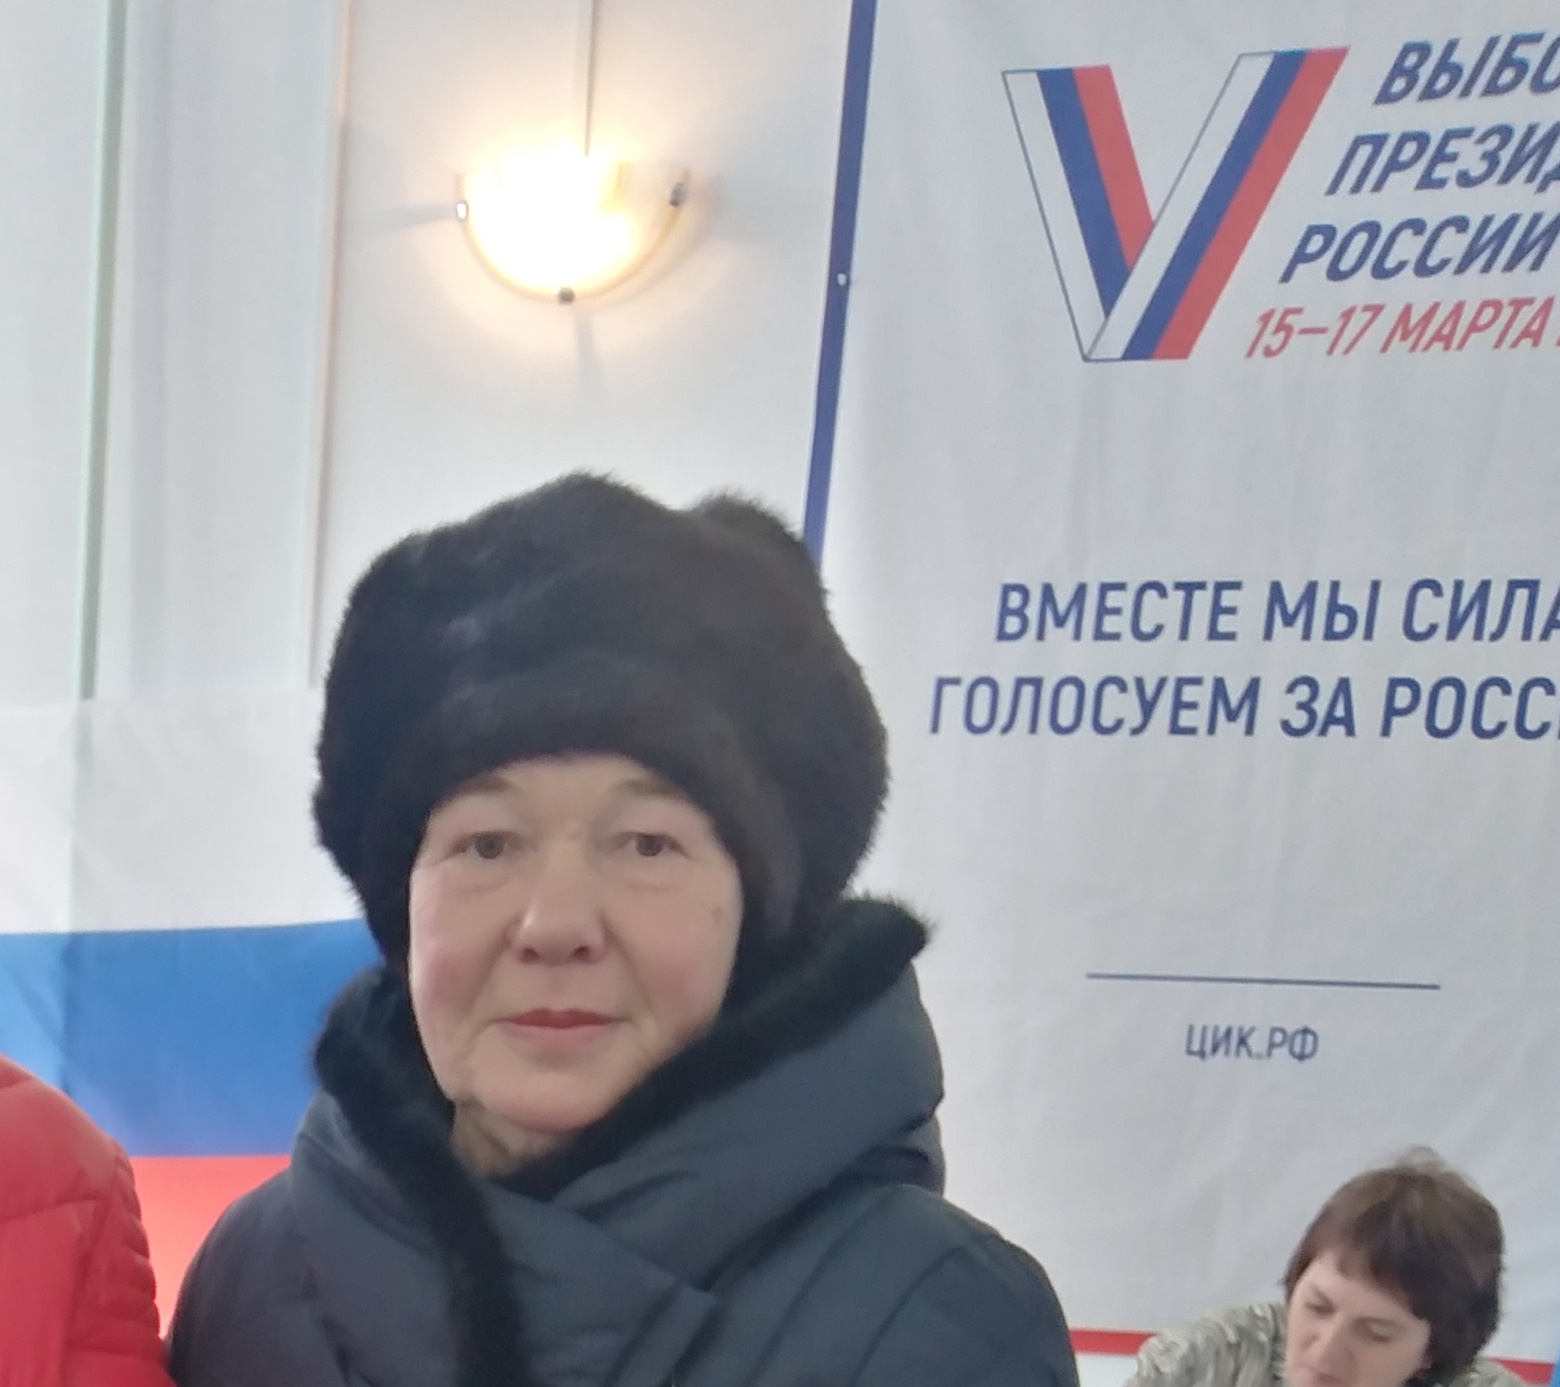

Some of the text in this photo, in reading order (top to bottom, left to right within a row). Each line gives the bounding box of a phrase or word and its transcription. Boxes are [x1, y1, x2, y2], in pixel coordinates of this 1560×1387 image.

[1324, 121, 1560, 197] ПРЕЗИ
[1278, 211, 1560, 284] РОССИИ
[1378, 296, 1556, 354] МАРТА
[995, 580, 1244, 642] ВМЕСТЕ
[1262, 579, 1382, 642] МЫ
[929, 675, 1560, 740] ГОЛОСУЕМ ЗА РОСС
[1185, 1023, 1320, 1063] ЦИК.РФ
